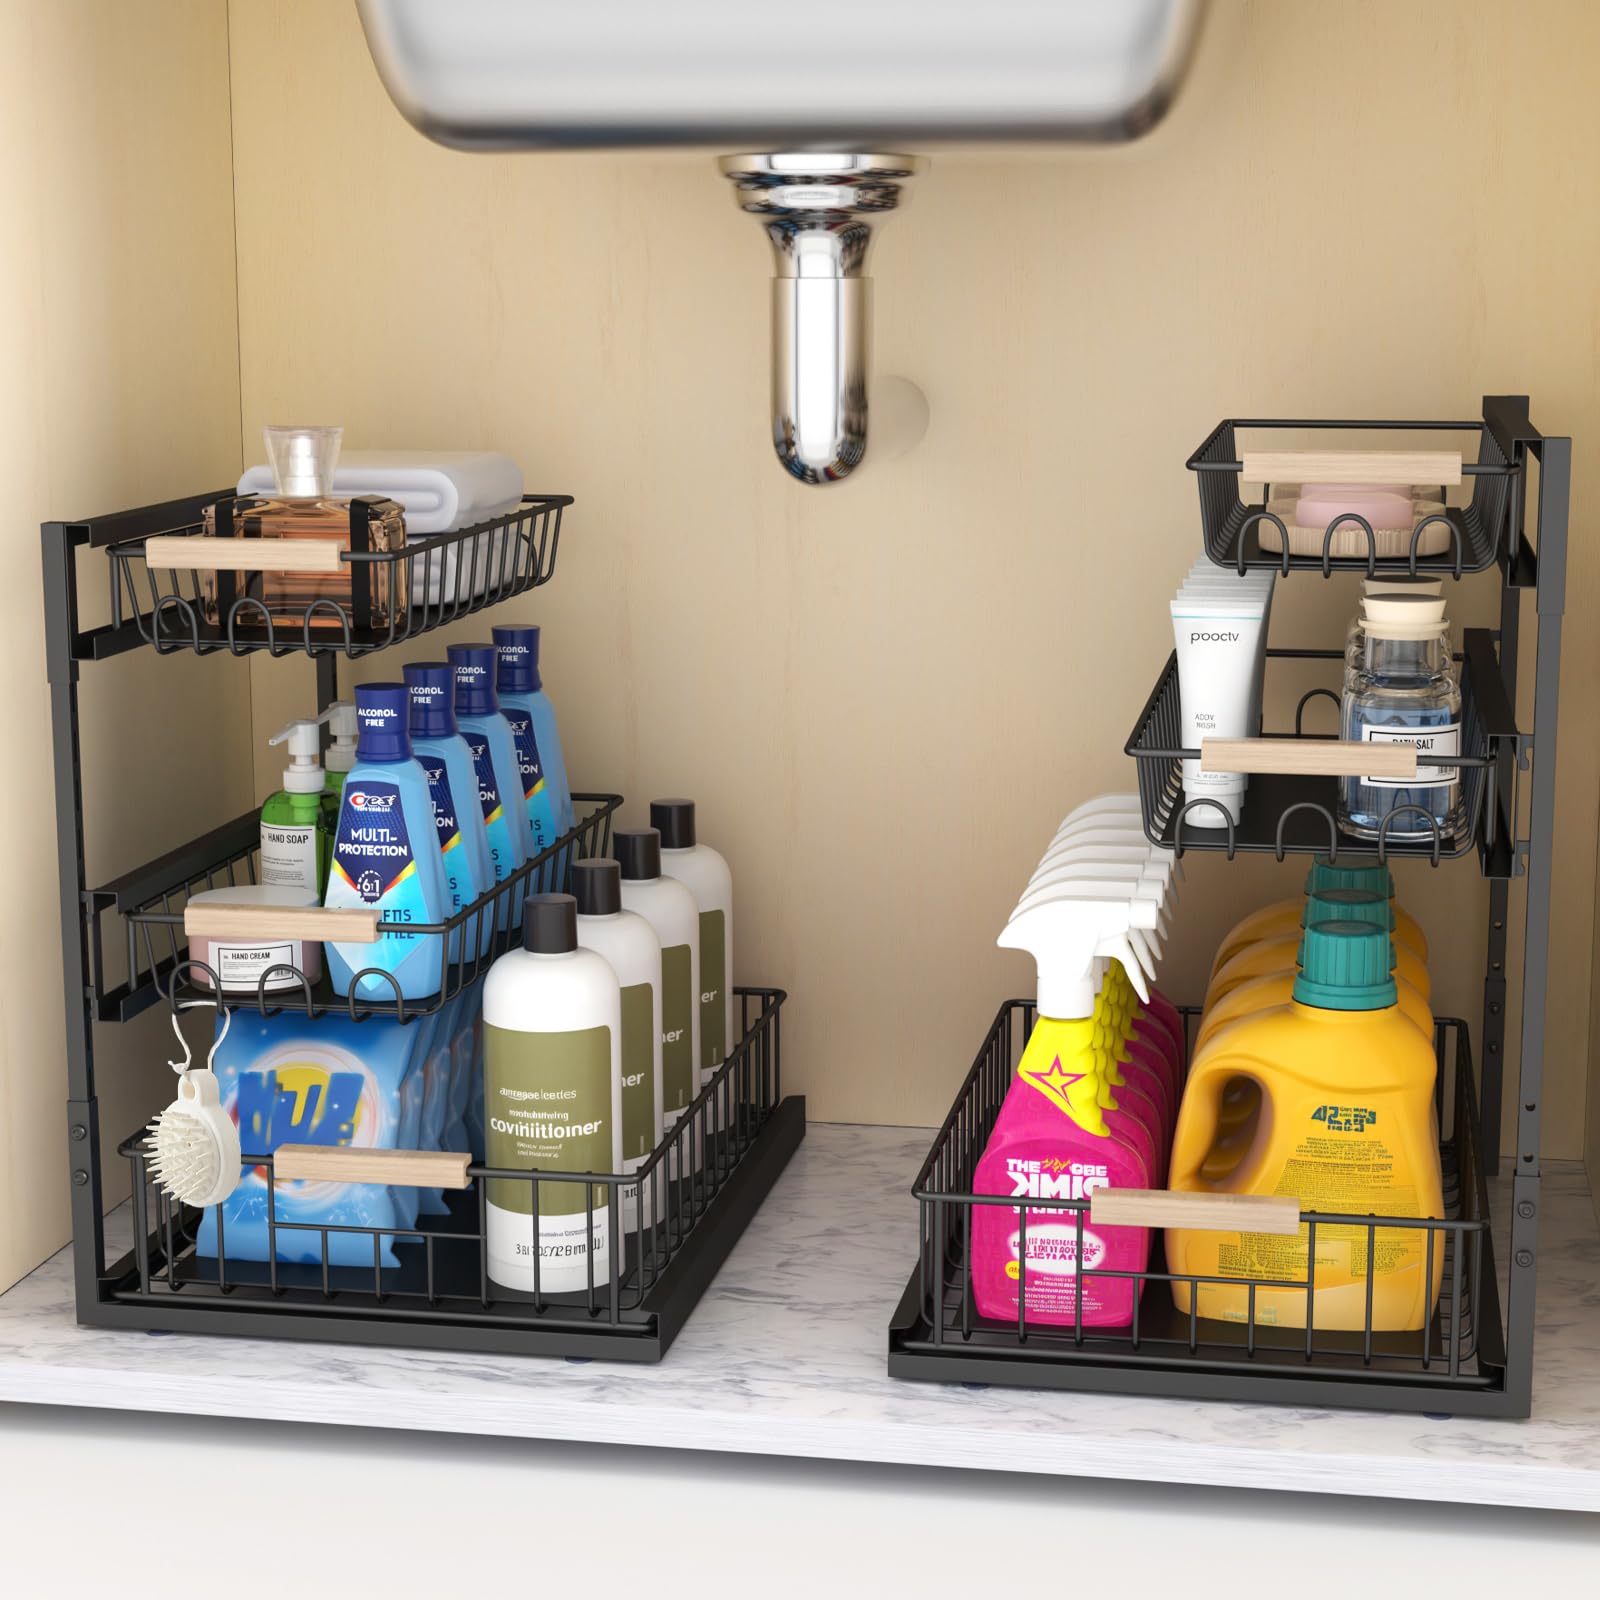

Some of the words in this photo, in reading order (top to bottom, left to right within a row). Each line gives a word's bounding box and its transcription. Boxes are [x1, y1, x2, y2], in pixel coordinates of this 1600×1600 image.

[1416, 738, 1435, 750] SALT
[268, 834, 285, 844] HAND
[286, 834, 309, 845] SOAP
[351, 828, 398, 842] MULTI-
[339, 843, 408, 857] PROTECTION
[231, 953, 249, 961] HAND
[250, 952, 271, 960] CREAM
[1006, 1158, 1041, 1173] THE
